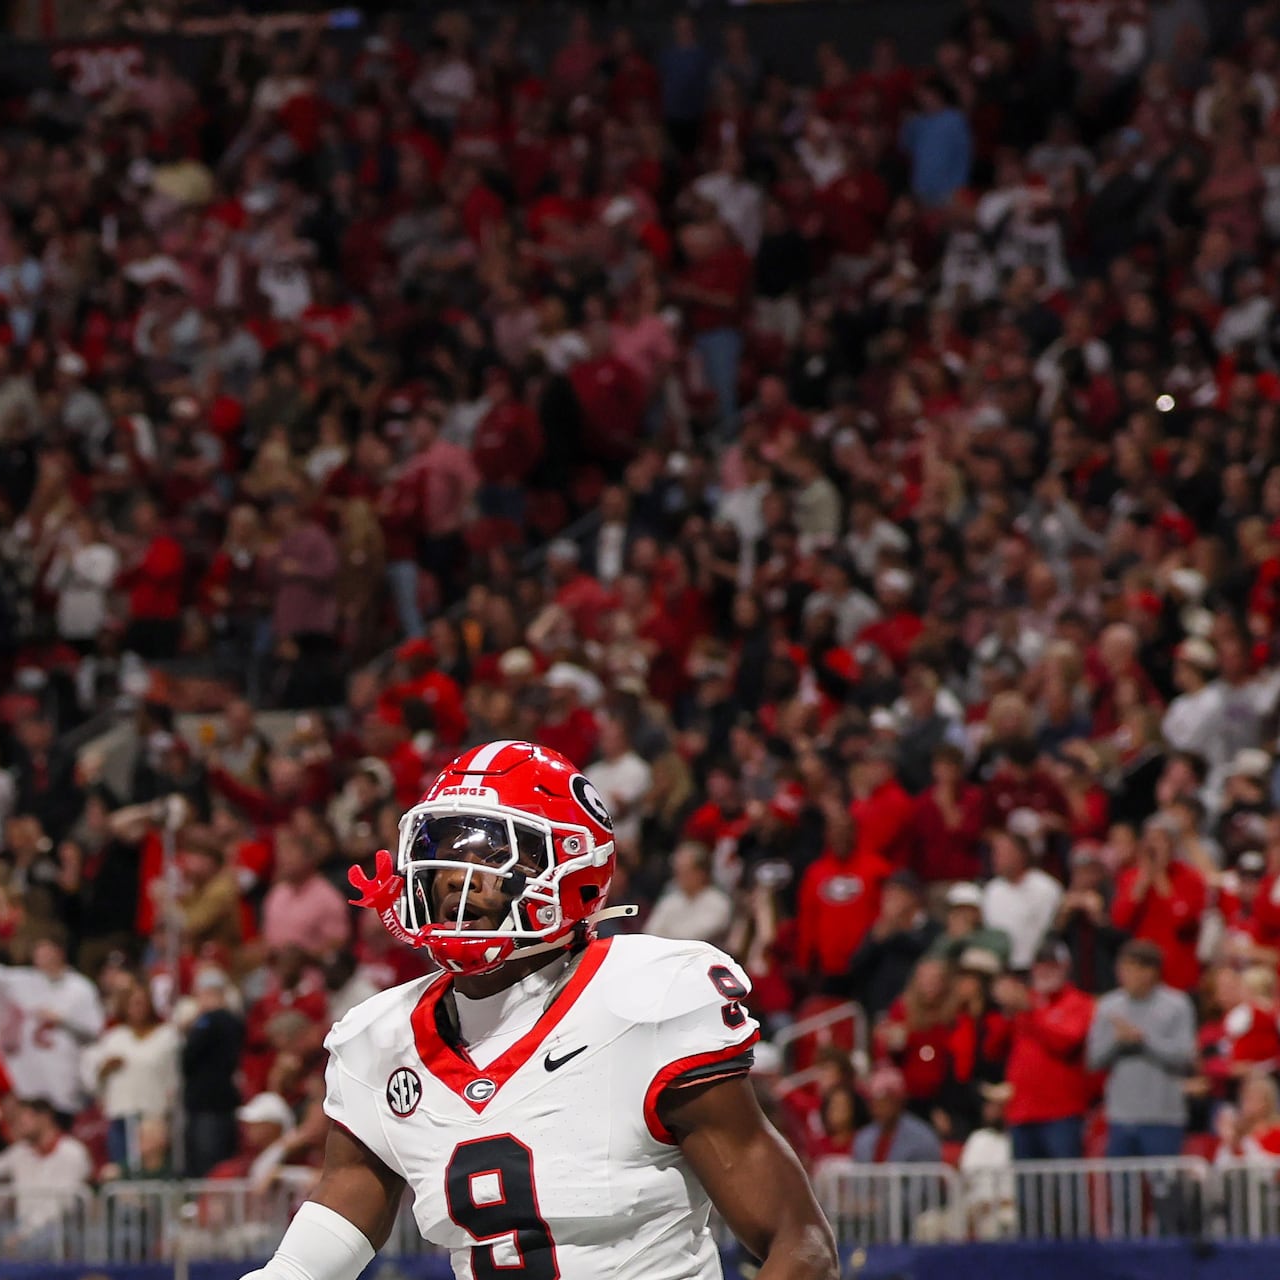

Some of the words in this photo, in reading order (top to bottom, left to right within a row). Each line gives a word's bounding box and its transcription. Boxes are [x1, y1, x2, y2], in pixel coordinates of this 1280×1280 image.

[443, 787, 487, 796] DAWGS
[707, 964, 748, 1030] 9
[391, 1070, 420, 1114] SEC
[466, 1081, 496, 1101] G
